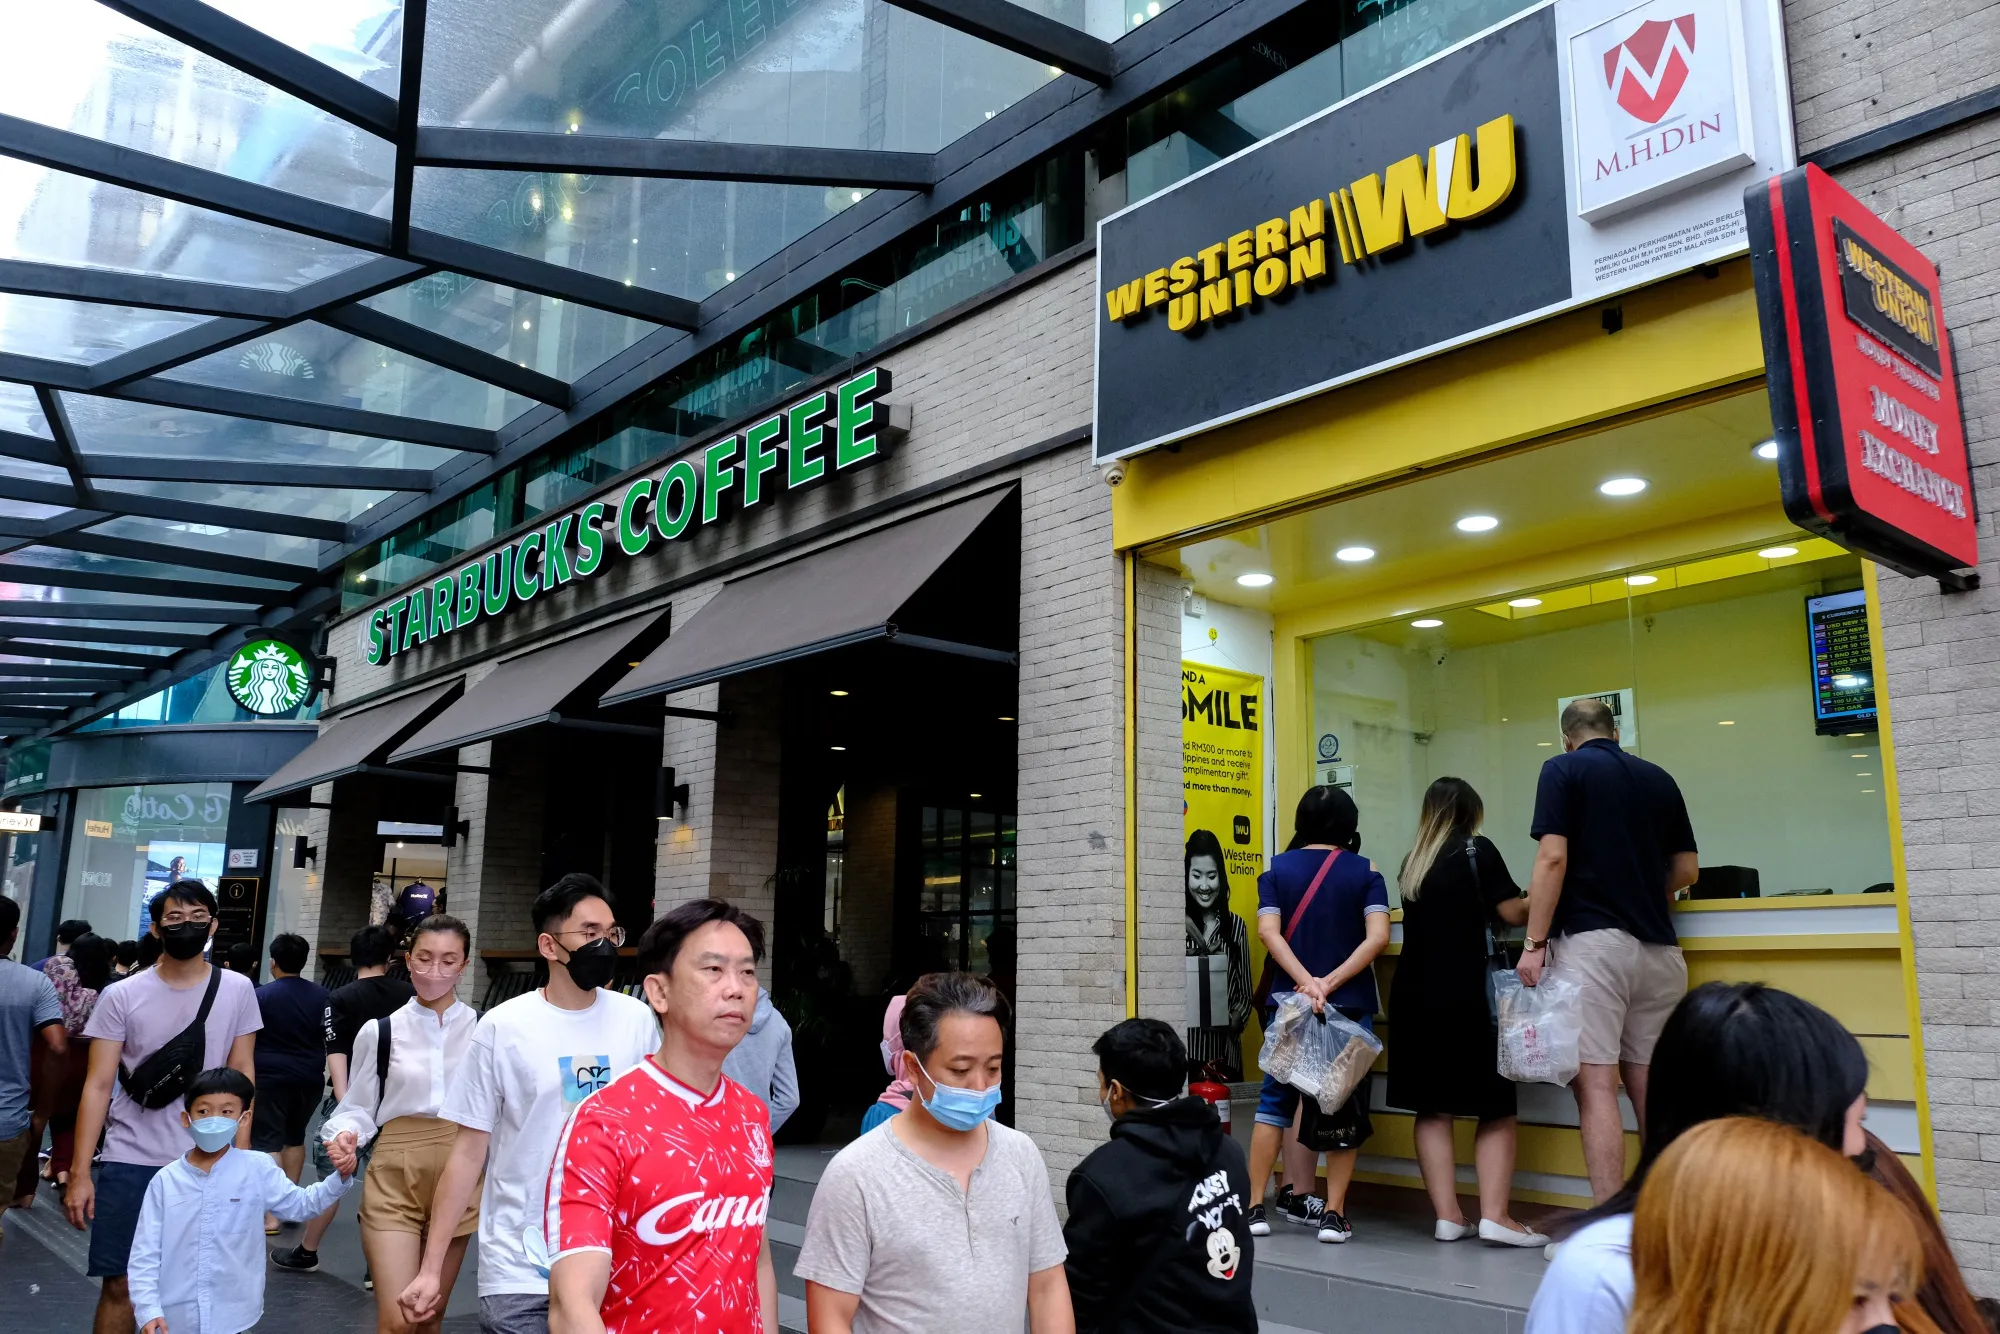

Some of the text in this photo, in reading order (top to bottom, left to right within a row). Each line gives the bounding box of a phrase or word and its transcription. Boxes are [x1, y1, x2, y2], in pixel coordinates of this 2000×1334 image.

[1595, 112, 1722, 181] M.H.DIN
[1350, 113, 1517, 257] WU
[1105, 198, 1325, 323] WESTERN
[1594, 246, 1637, 265] PERNIAGAAN
[1638, 227, 1691, 250] PERKHIDMATAN
[1692, 219, 1714, 234] WANG
[1595, 266, 1627, 282] WESTERN
[1629, 258, 1650, 271] UNION
[1651, 247, 1683, 264] PAYMENT
[1684, 235, 1720, 252] MALAYSIA
[1721, 230, 1736, 241] SDN
[1595, 261, 1621, 274] DIMILIKI
[1621, 253, 1640, 265] OLEH
[1641, 249, 1654, 259] M.H
[1655, 245, 1667, 256] DIN
[1668, 240, 1684, 250] SDN.
[1167, 238, 1326, 333] UNION
[1845, 238, 1929, 319] WESTERN
[1873, 283, 1933, 345] UNION
[1869, 384, 1940, 454] MONEY
[1857, 430, 1967, 519] EXCHANGE
[366, 366, 880, 666] STARBUCKS COFFEE
[1198, 674, 1206, 685] A
[1192, 742, 1216, 754] RM300
[1217, 746, 1225, 755] or
[1226, 748, 1247, 758] more
[1247, 751, 1253, 759] to
[1211, 757, 1225, 767] and
[1227, 759, 1251, 770] receive
[1192, 782, 1211, 792] more
[1212, 784, 1230, 794] than
[1231, 786, 1252, 798] money.
[1224, 848, 1263, 862] Western
[1230, 863, 1255, 876] Union
[636, 1186, 771, 1246] Cand
